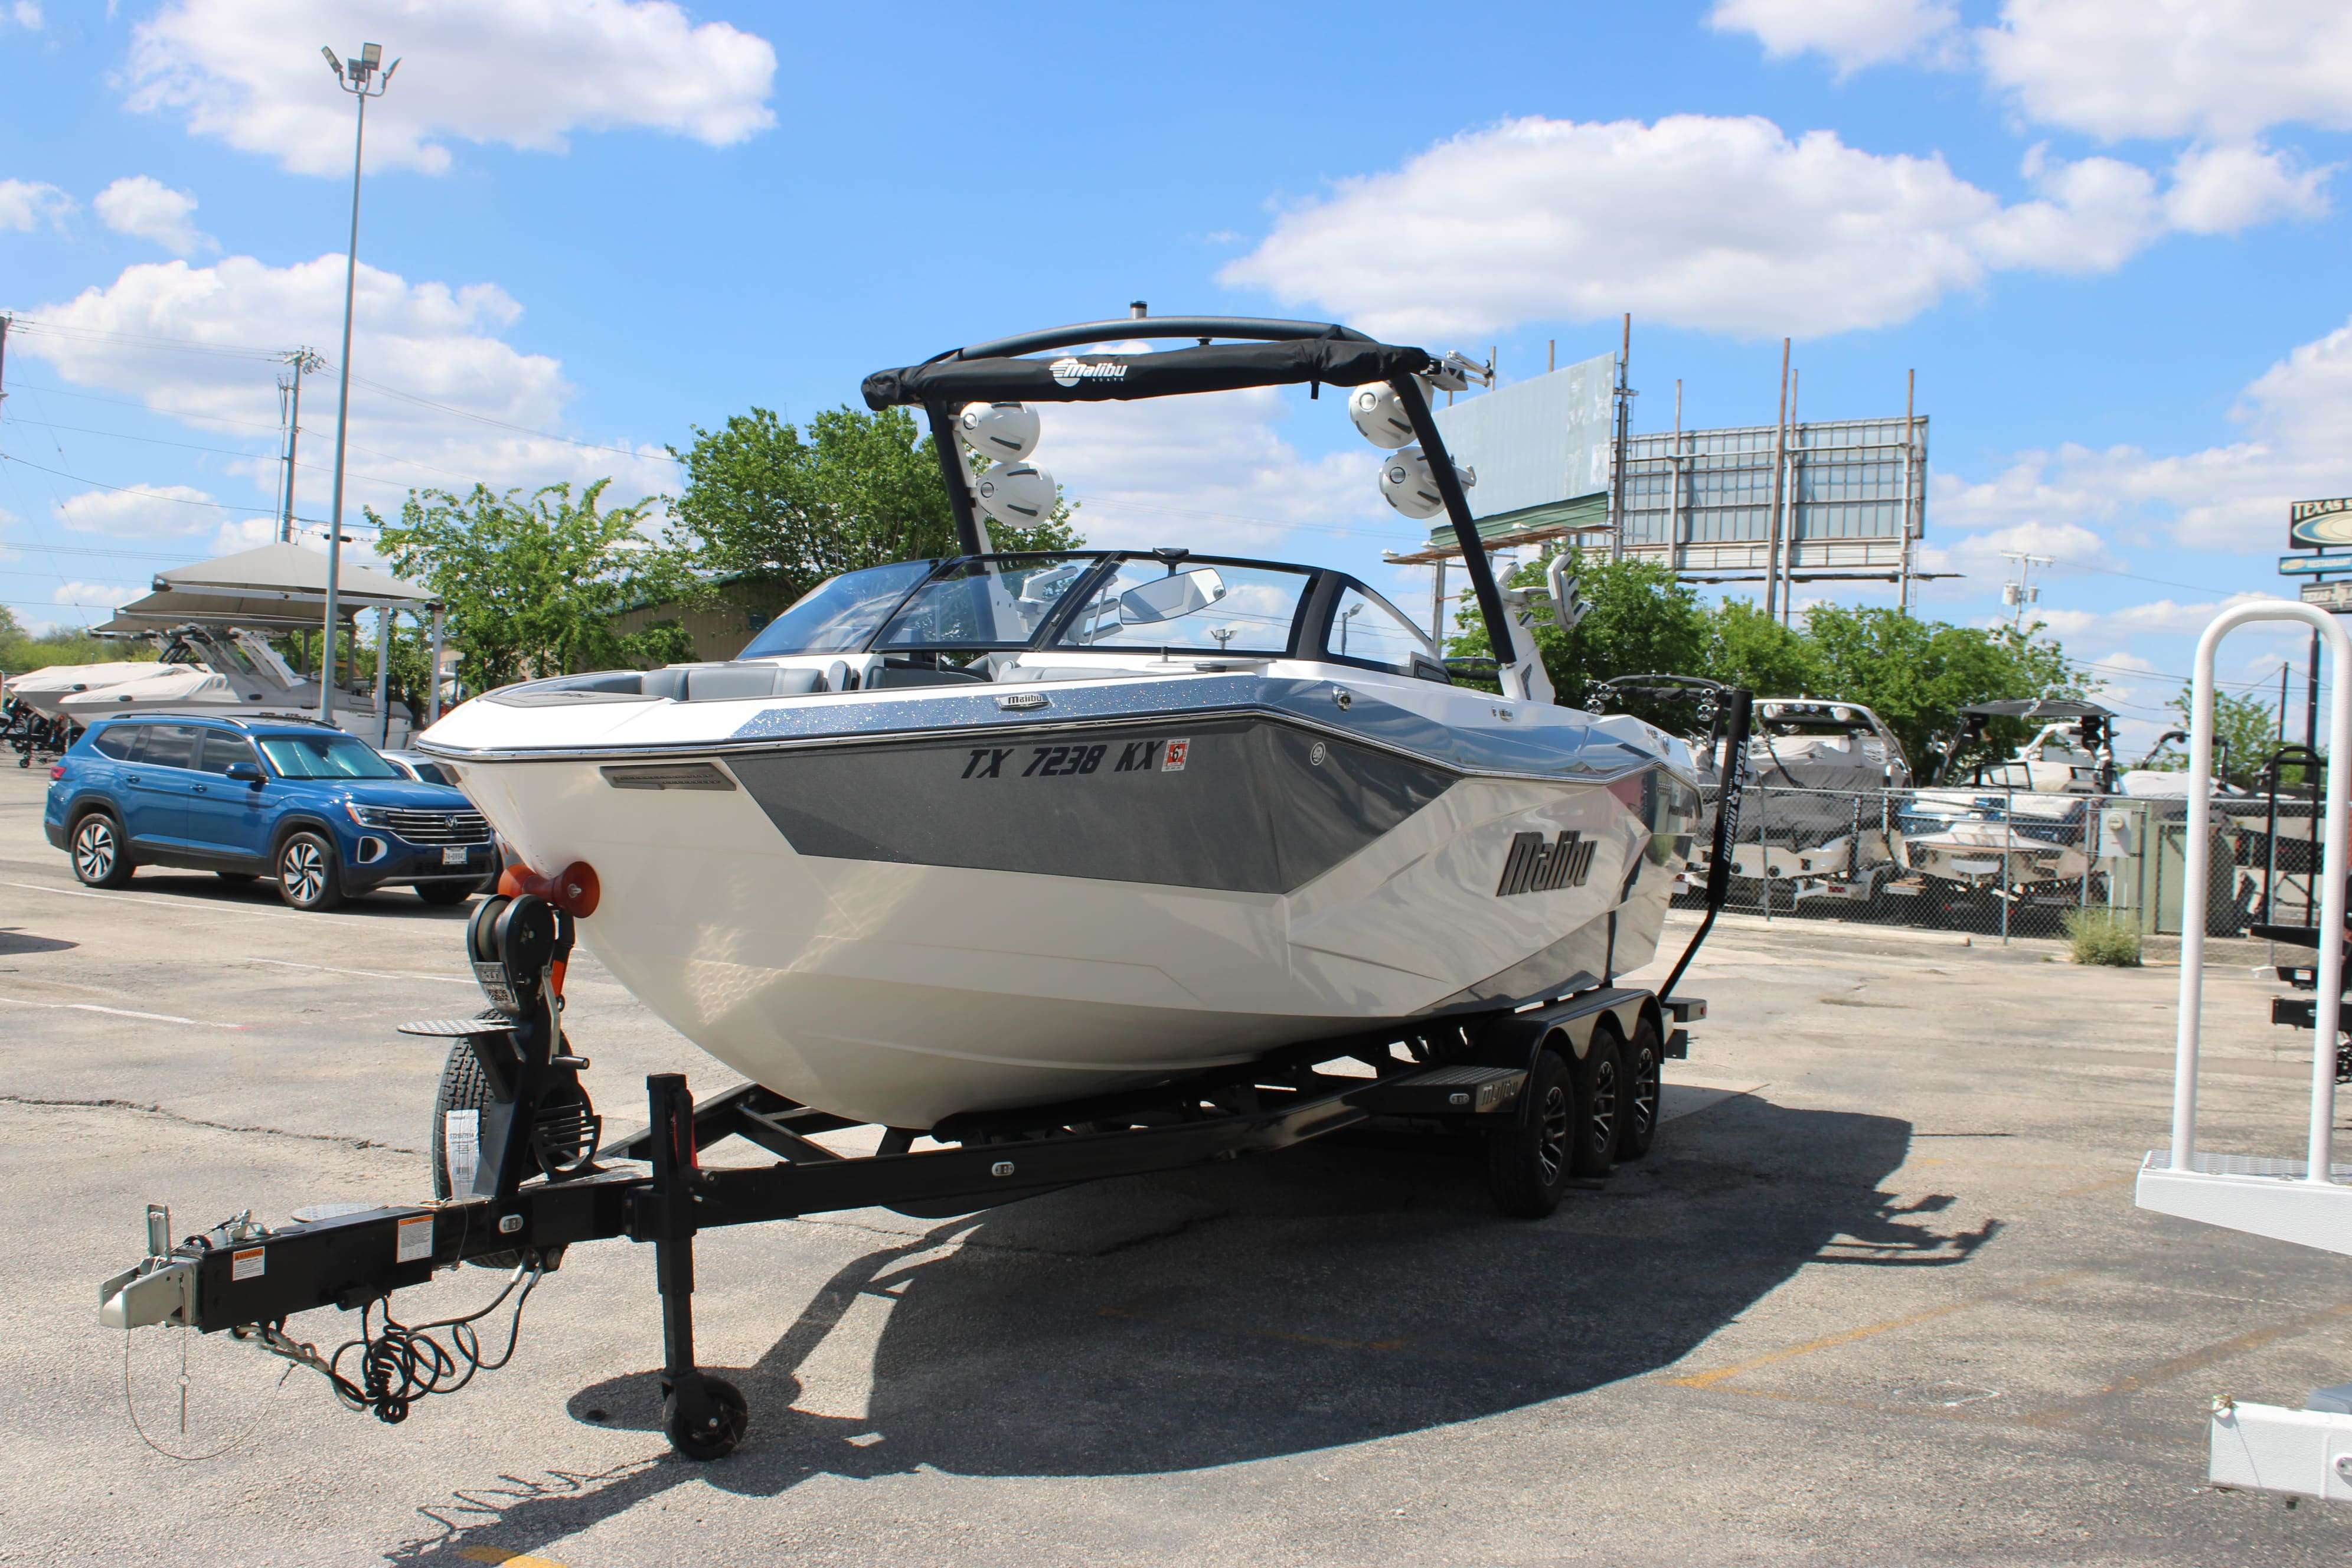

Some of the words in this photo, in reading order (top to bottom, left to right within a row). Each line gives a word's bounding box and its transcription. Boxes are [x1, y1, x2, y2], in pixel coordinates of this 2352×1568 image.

[1063, 356, 1128, 377] Malibu
[2294, 499, 2343, 520] TEXAS
[1008, 695, 1042, 704] Malibu
[961, 748, 1015, 779] TX
[1021, 744, 1108, 777] 7238
[1114, 740, 1165, 772] KX
[1172, 745, 1180, 762] 6
[1733, 740, 1747, 786] TEXAS
[1723, 806, 1738, 863] Malibu
[1496, 830, 1598, 897] Malibu
[1482, 1079, 1519, 1106] Malibu
